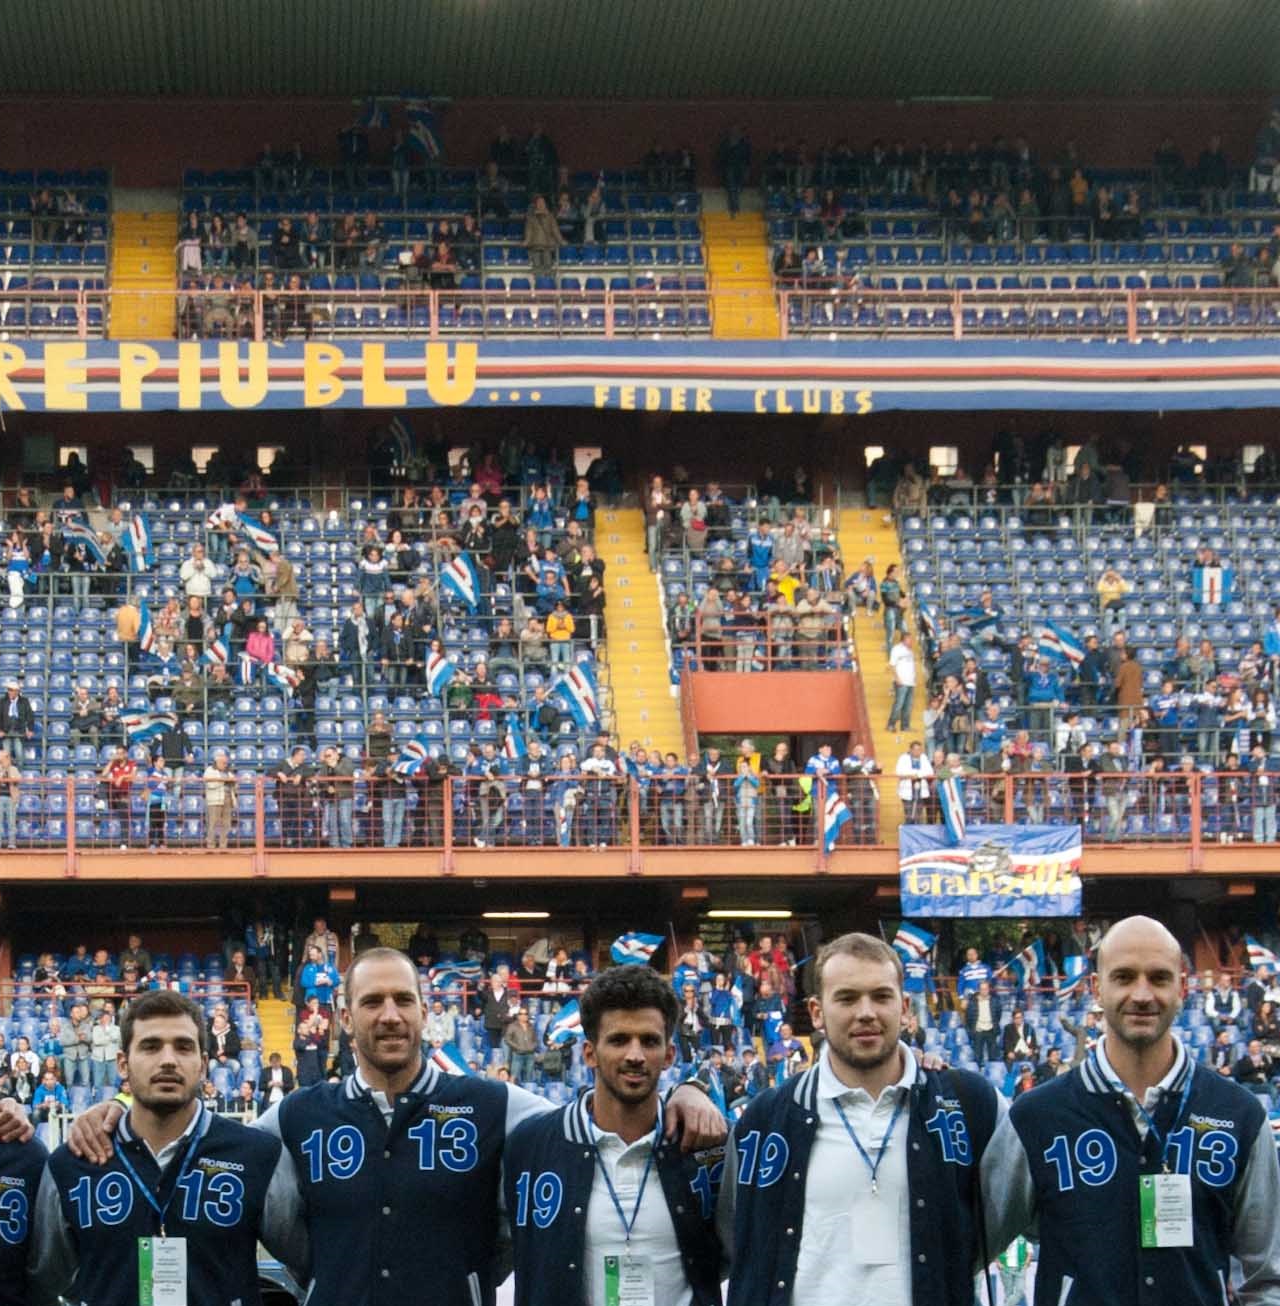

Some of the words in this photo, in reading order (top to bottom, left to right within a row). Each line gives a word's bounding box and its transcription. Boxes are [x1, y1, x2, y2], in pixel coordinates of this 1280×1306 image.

[594, 385, 713, 413] FEDER
[754, 387, 873, 414] CLUBS
[302, 1125, 366, 1183] 19
[408, 1117, 480, 1173] 13
[737, 1130, 790, 1189] 19
[927, 1108, 973, 1167] 13
[1045, 1128, 1117, 1191] 19
[1167, 1126, 1240, 1187] 13
[69, 1171, 134, 1229] 19
[177, 1169, 245, 1227] 13
[515, 1171, 563, 1229] 19
[690, 1160, 725, 1220] 1
